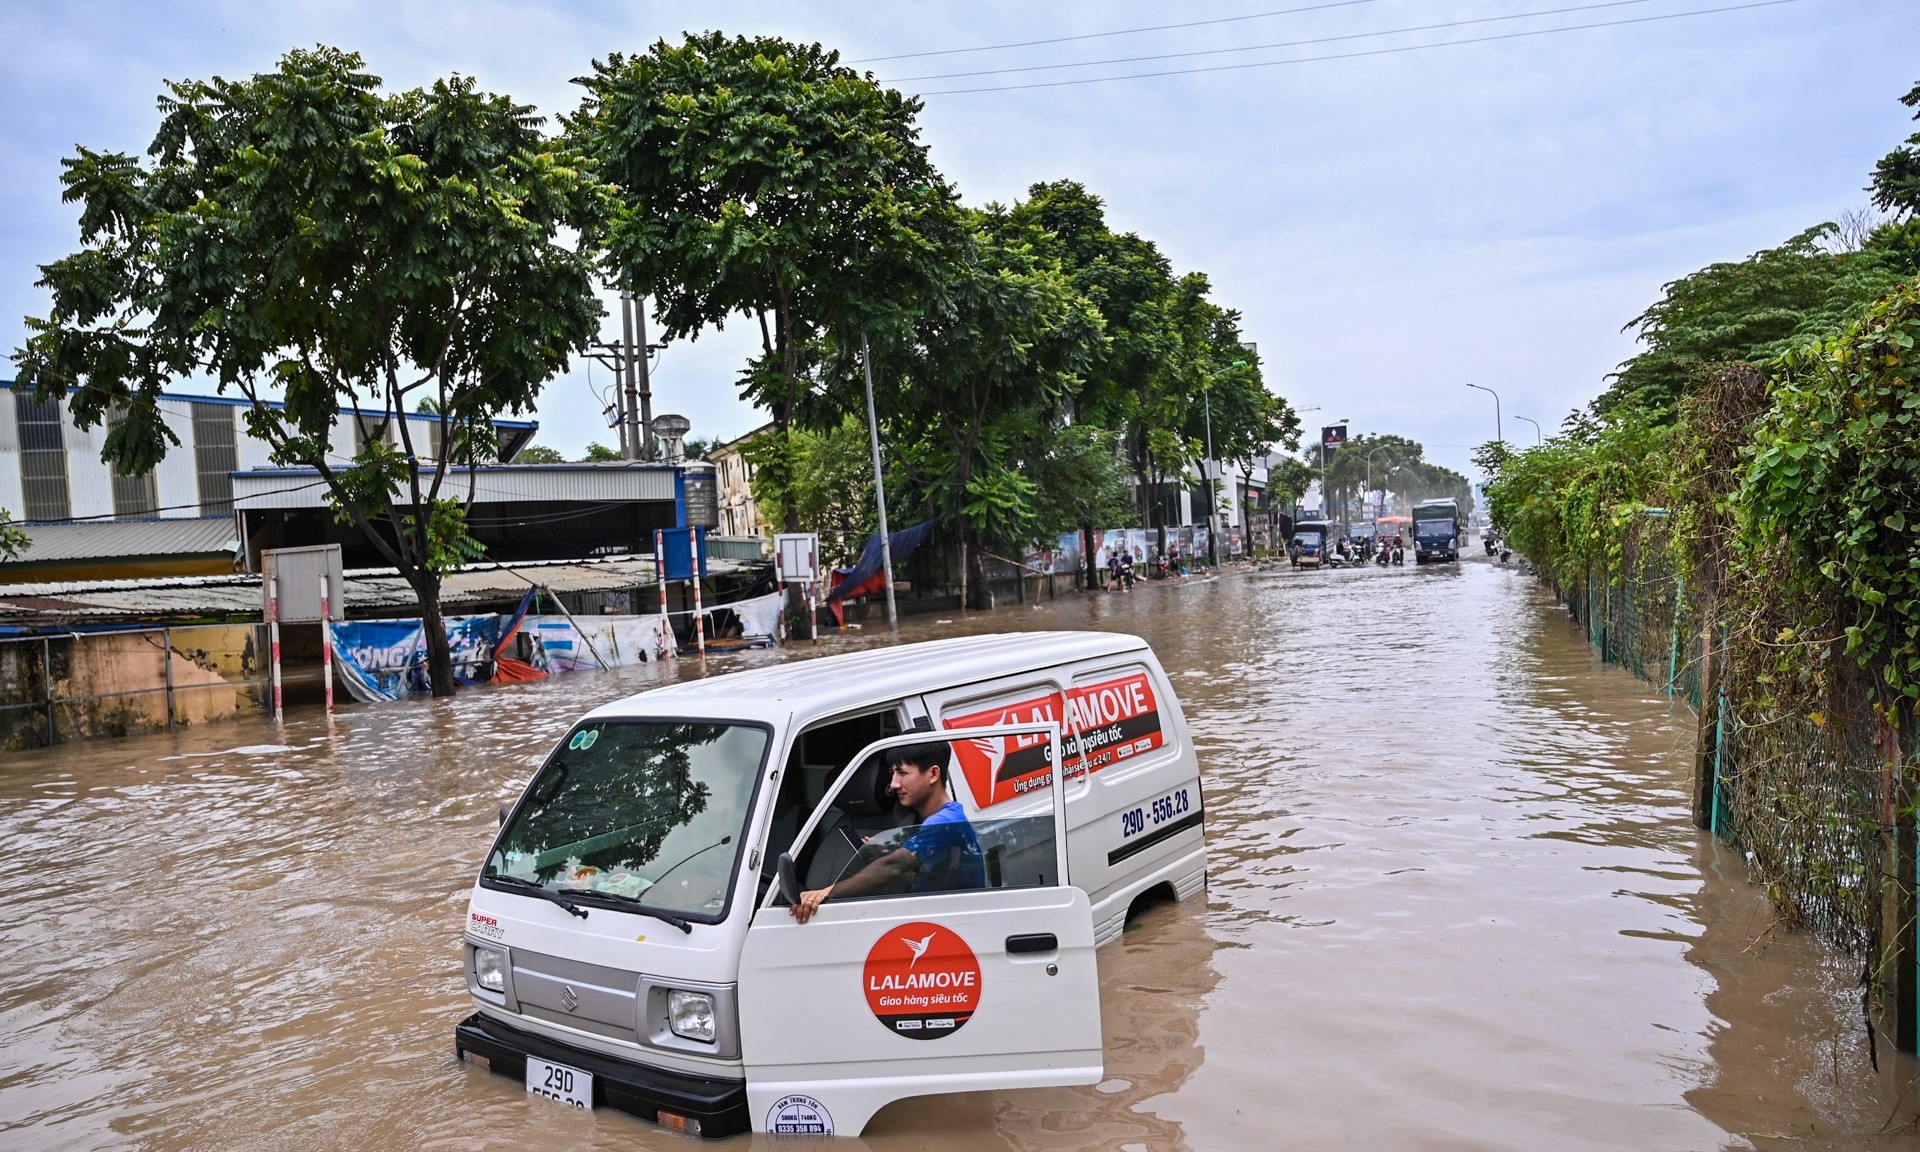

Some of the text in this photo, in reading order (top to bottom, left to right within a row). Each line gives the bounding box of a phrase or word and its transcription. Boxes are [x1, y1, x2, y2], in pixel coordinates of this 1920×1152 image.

[1011, 681, 1148, 748] LALAMOVE
[1108, 723, 1123, 742] tốc
[1013, 779, 1029, 793] Ứng
[1028, 775, 1046, 789] dụng
[1122, 807, 1144, 839] 29D
[1152, 788, 1189, 825] 556.28
[471, 913, 498, 927] SUPER
[470, 920, 505, 940] CARRY
[870, 971, 976, 991] LALAMOVE
[879, 991, 969, 1007] Giao hàng siêu tốc
[544, 1065, 574, 1094] 29D
[778, 1124, 795, 1133] 0335
[795, 1124, 808, 1133] 358
